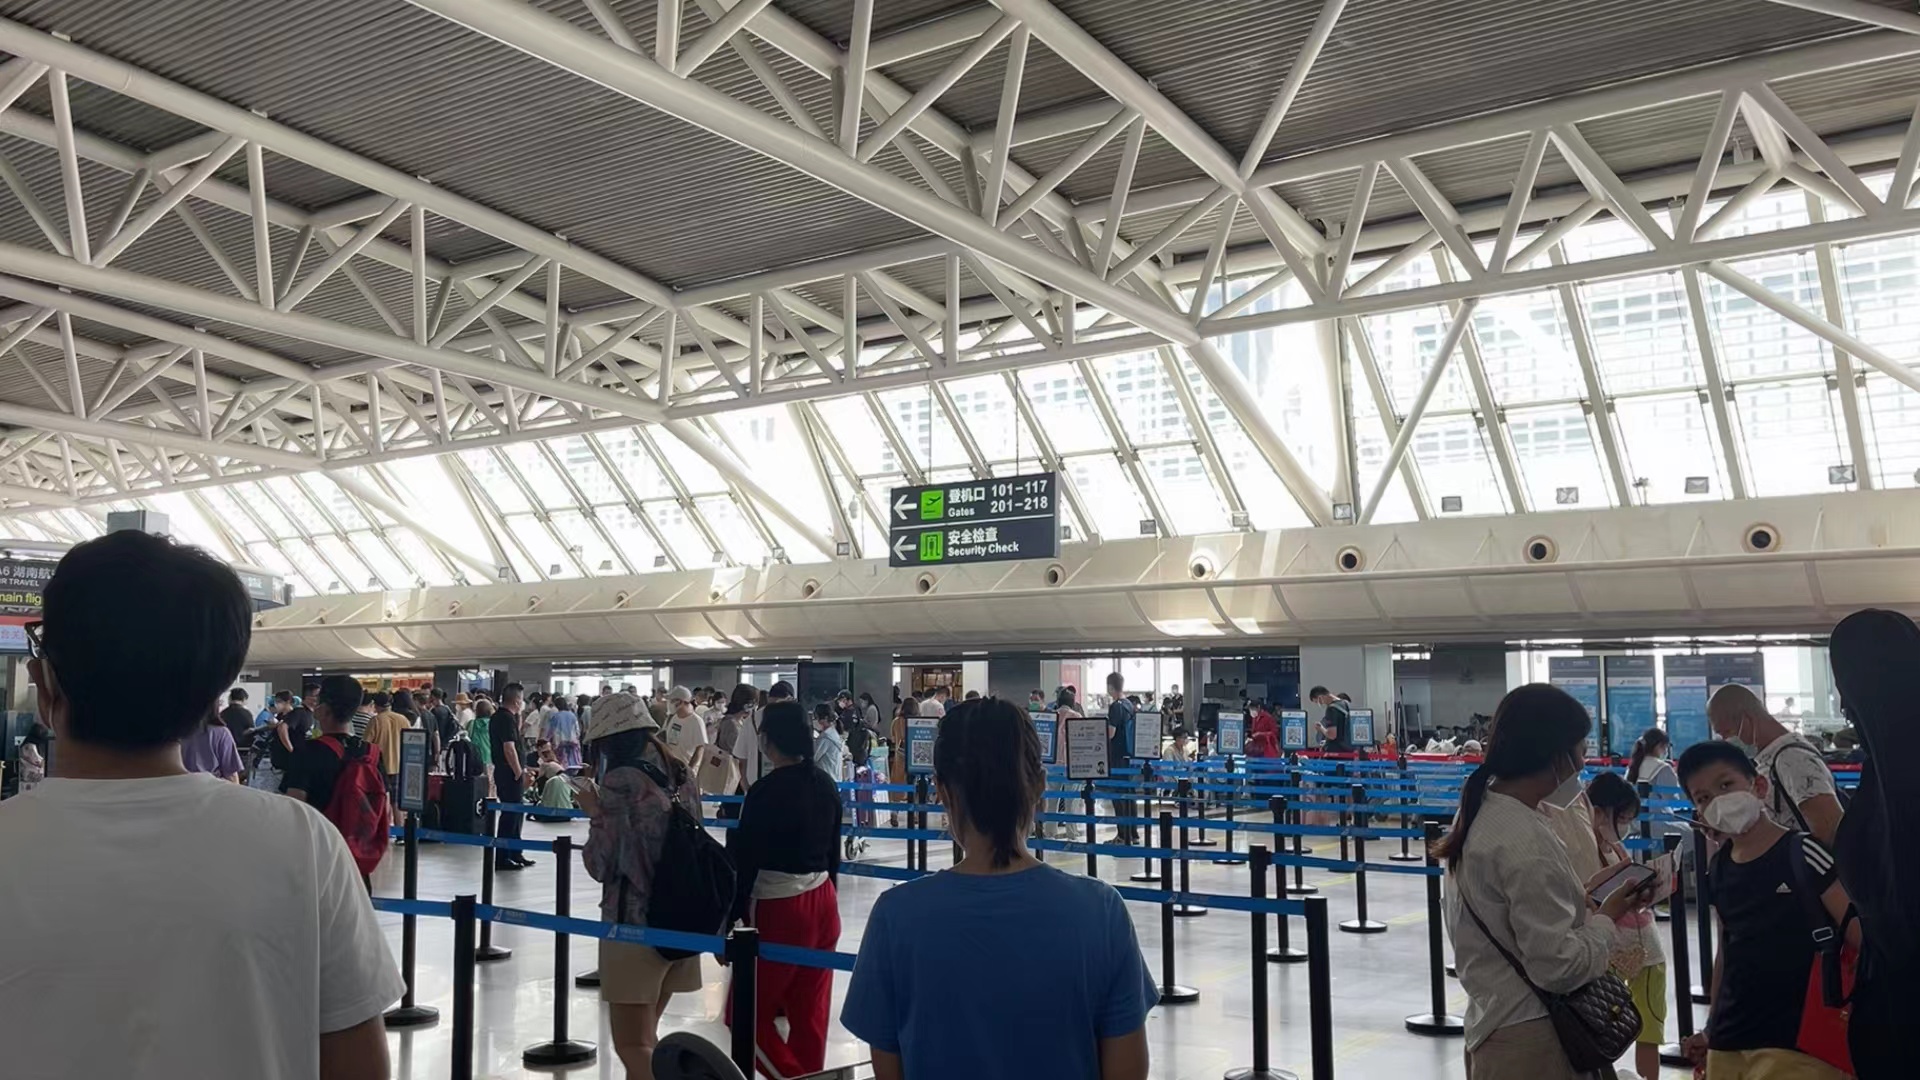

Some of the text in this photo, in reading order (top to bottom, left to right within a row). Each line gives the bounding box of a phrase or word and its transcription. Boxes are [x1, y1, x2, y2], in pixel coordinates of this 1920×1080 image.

[948, 480, 1048, 504] 登机口 101-117
[948, 507, 975, 518] Gates
[990, 496, 1048, 513] 201-218
[948, 527, 998, 545] 安全检查
[948, 541, 1019, 557] Security Check
[0, 565, 55, 579] 6 湖南航
[9, 579, 40, 587] TRAVEL
